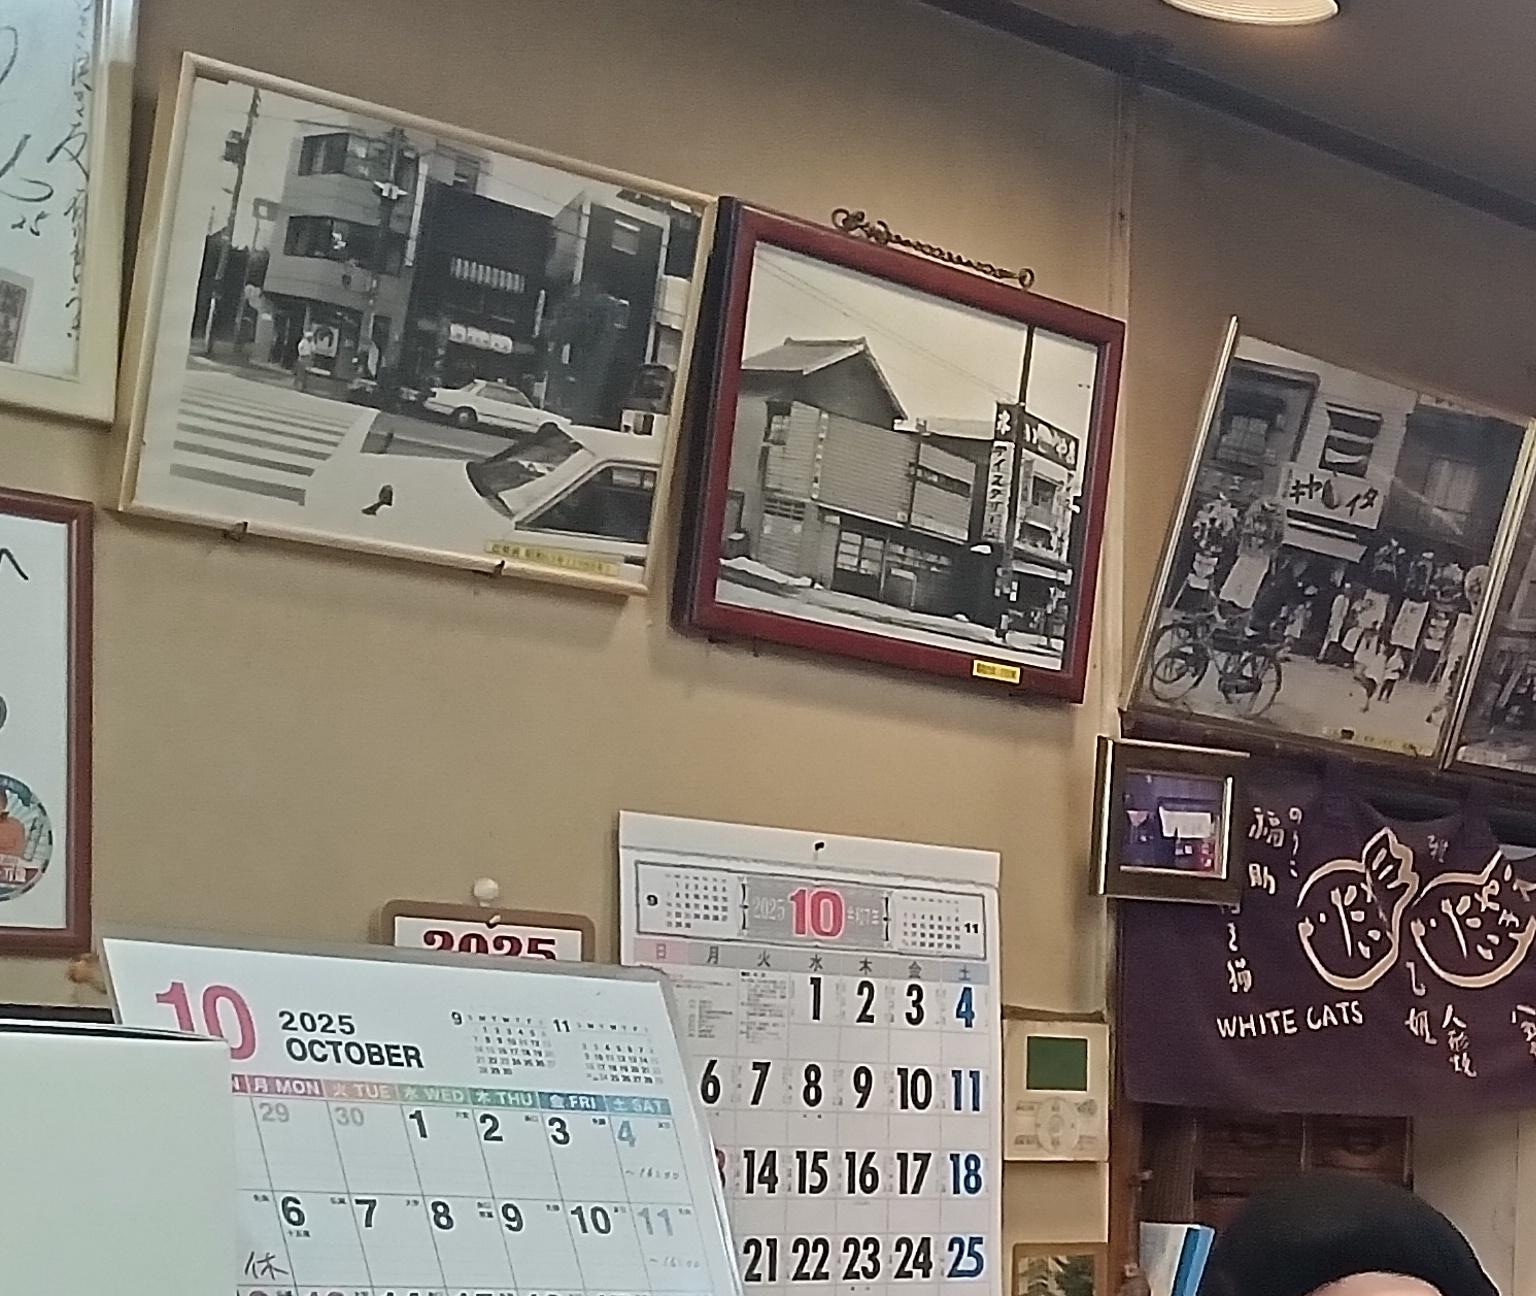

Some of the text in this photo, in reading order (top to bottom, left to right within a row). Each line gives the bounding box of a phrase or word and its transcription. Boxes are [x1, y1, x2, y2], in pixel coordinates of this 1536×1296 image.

[645, 894, 659, 907] 9
[790, 887, 844, 938] 10
[964, 922, 980, 934] 11
[655, 943, 972, 978] 日 月 火 水 木 金 土
[451, 1011, 463, 1026] 9
[809, 976, 822, 1021] 1
[856, 980, 875, 1024] 2
[904, 983, 925, 1026] 3
[956, 987, 975, 1028] 4
[1217, 1000, 1364, 1039] WHITE CATS
[155, 981, 256, 1061] 10
[278, 1010, 356, 1036] 2025
[553, 1019, 571, 1033] 11
[285, 1037, 424, 1069] OCTOBER
[276, 1079, 321, 1096] MON
[355, 1084, 391, 1099] TUE
[425, 1089, 465, 1103] WED
[499, 1091, 533, 1106] THU
[569, 1095, 596, 1109] FRI
[632, 1099, 663, 1112] SAT
[700, 1059, 981, 1112] 6 7 8 9 10 11
[259, 1102, 636, 1147] 29 30 1 2 3 4
[743, 1149, 779, 1195] 14
[796, 1151, 829, 1195] 15
[845, 1151, 880, 1195] 16
[896, 1152, 932, 1195] 17
[949, 1153, 983, 1195] 18
[281, 1196, 305, 1226] 6
[354, 1198, 377, 1228] 7
[431, 1200, 454, 1230] 8
[501, 1203, 524, 1232] 9
[571, 1205, 611, 1234] 10
[638, 1207, 673, 1236] 11
[244, 1251, 289, 1281] 休
[742, 1236, 985, 1283] 21 22 23 24 25
